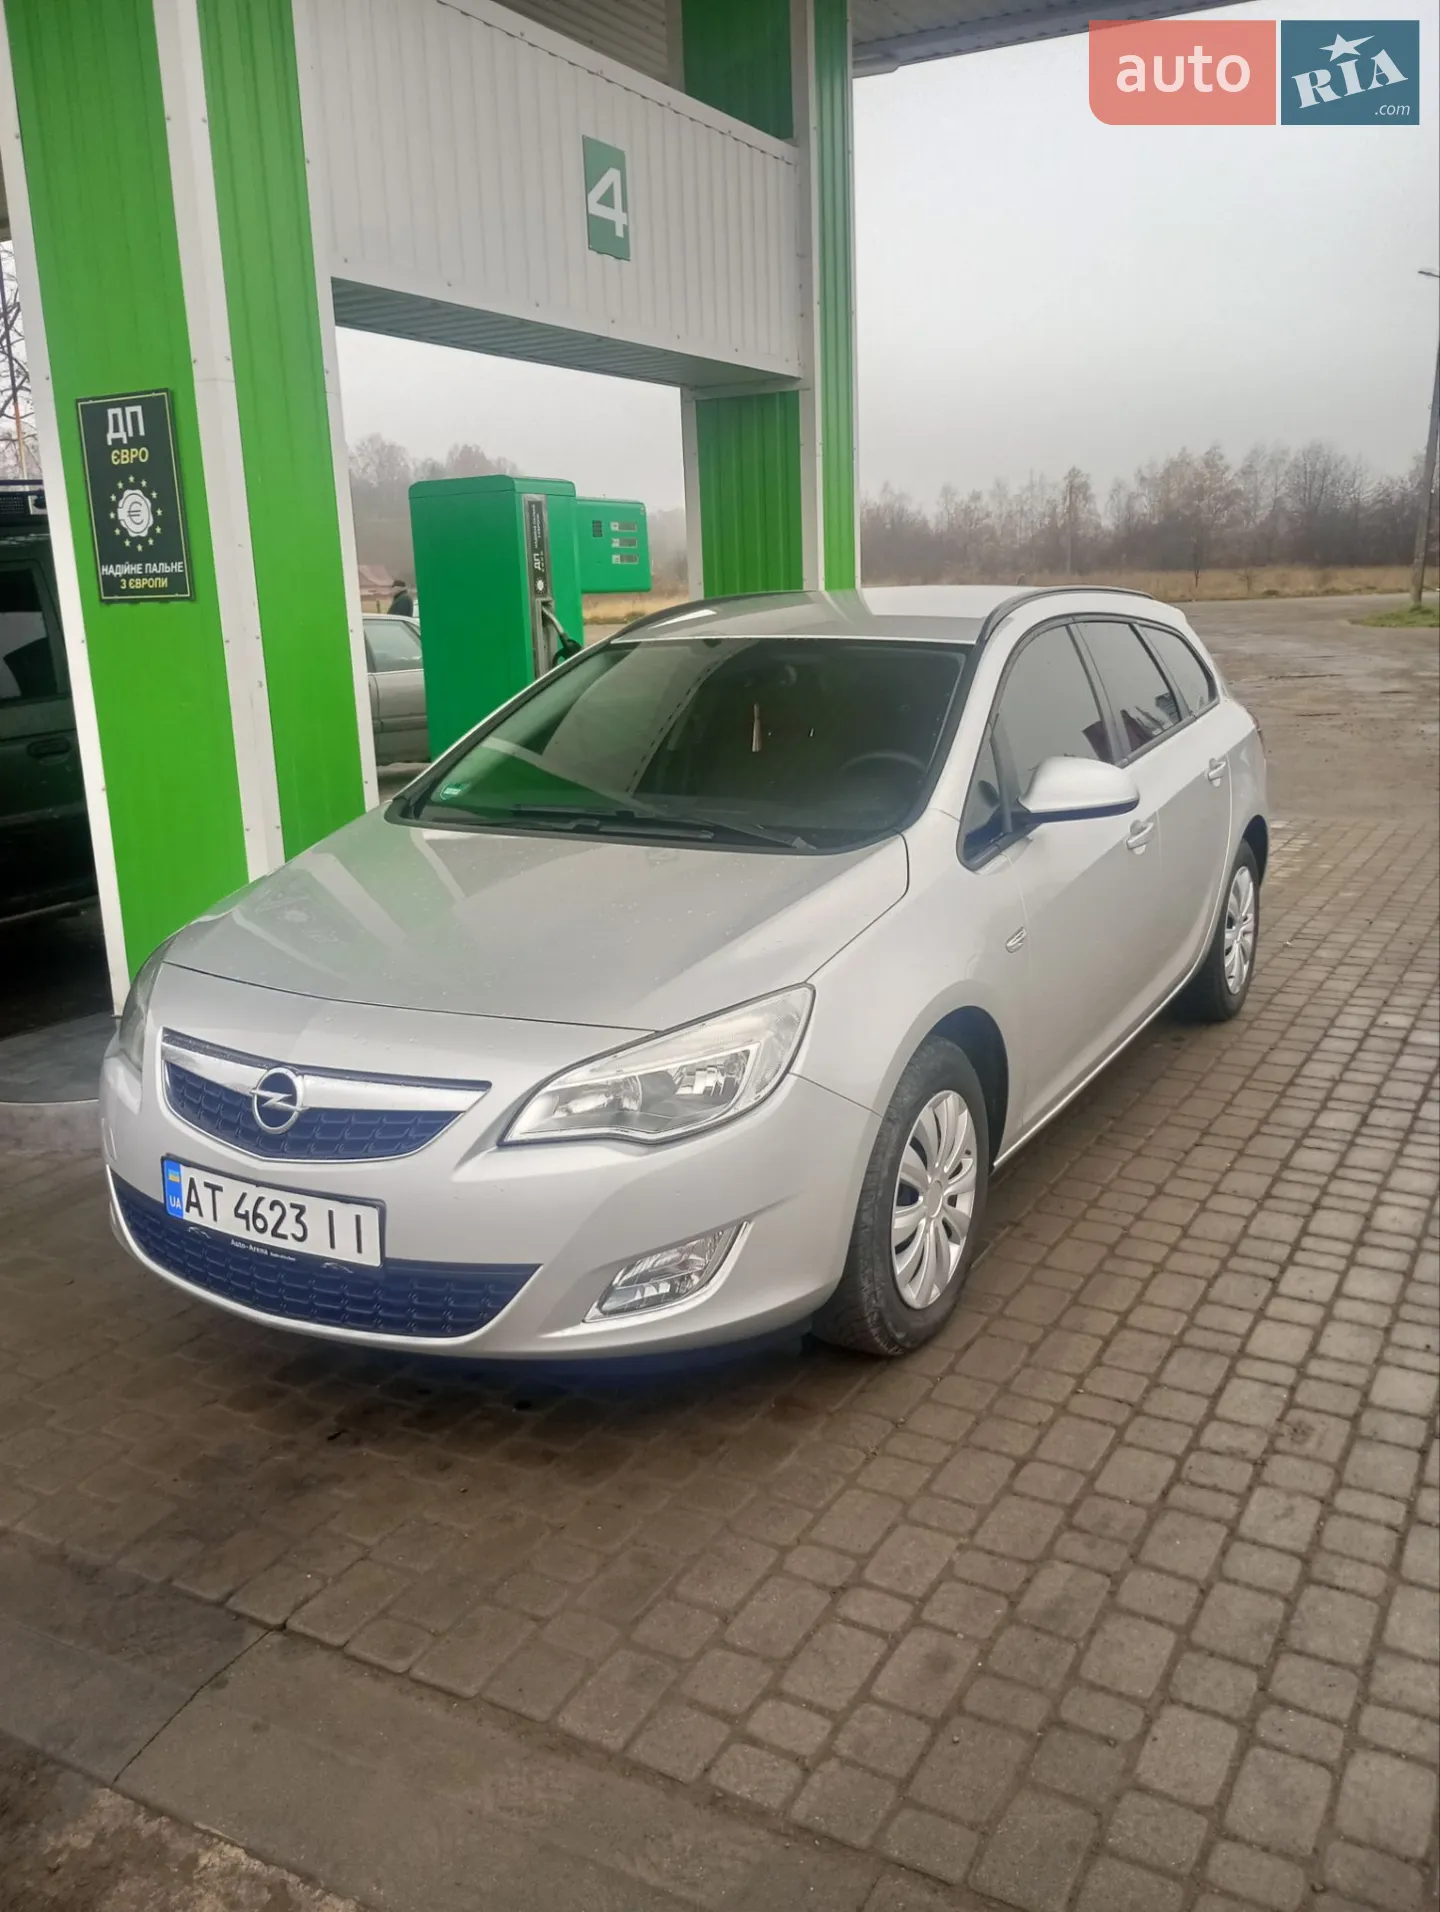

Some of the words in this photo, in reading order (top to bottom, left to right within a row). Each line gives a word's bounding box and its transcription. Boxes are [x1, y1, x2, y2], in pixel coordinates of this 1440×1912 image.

[587, 167, 629, 239] 4
[106, 405, 145, 446] ДП
[111, 447, 149, 466] ЄВРО
[101, 562, 143, 577] НАДІЙНЕ
[145, 561, 184, 575] ПАЛЬНЕ
[129, 577, 168, 589] ЄВРОПИ
[169, 1195, 182, 1210] UA
[185, 1177, 223, 1222] AT
[234, 1192, 308, 1243] 4623
